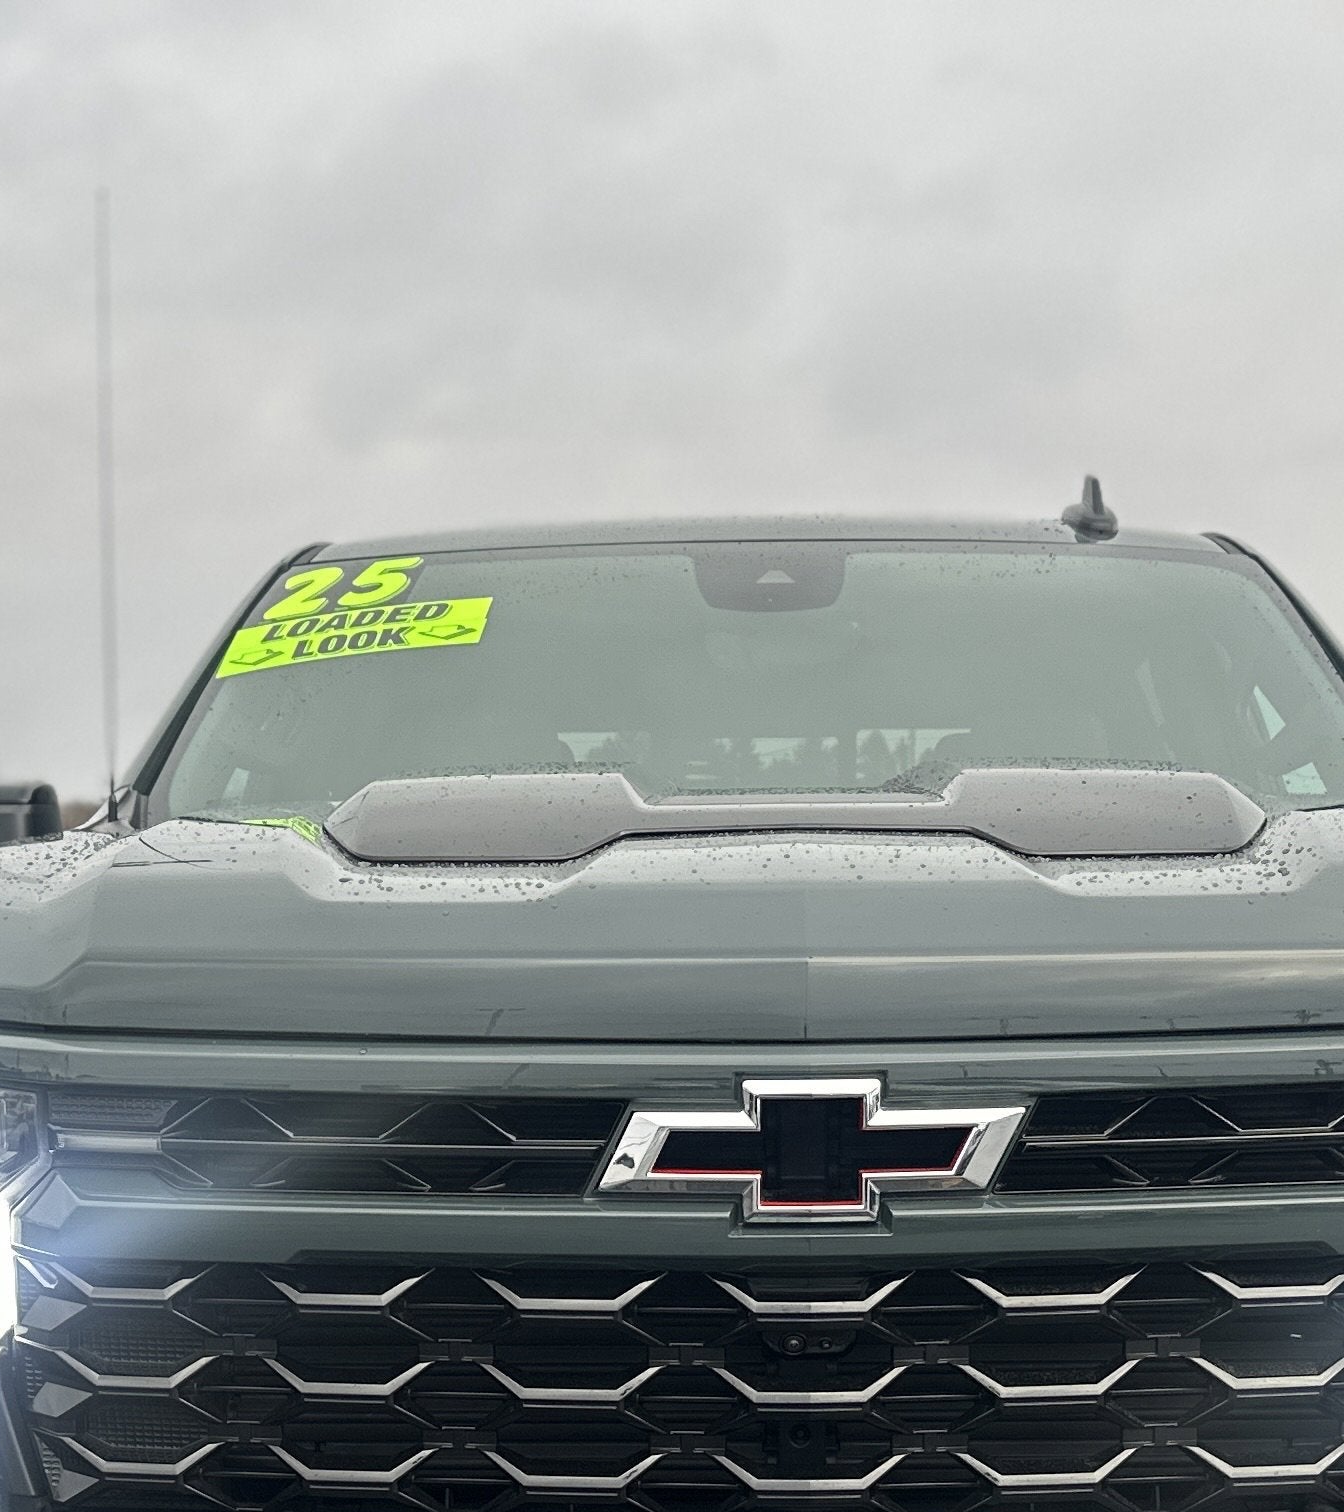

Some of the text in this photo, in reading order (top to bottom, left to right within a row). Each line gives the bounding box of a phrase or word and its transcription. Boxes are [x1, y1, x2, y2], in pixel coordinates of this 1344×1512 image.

[263, 556, 424, 620] 25
[261, 602, 453, 643] LOADED
[291, 626, 416, 660] LOOK
